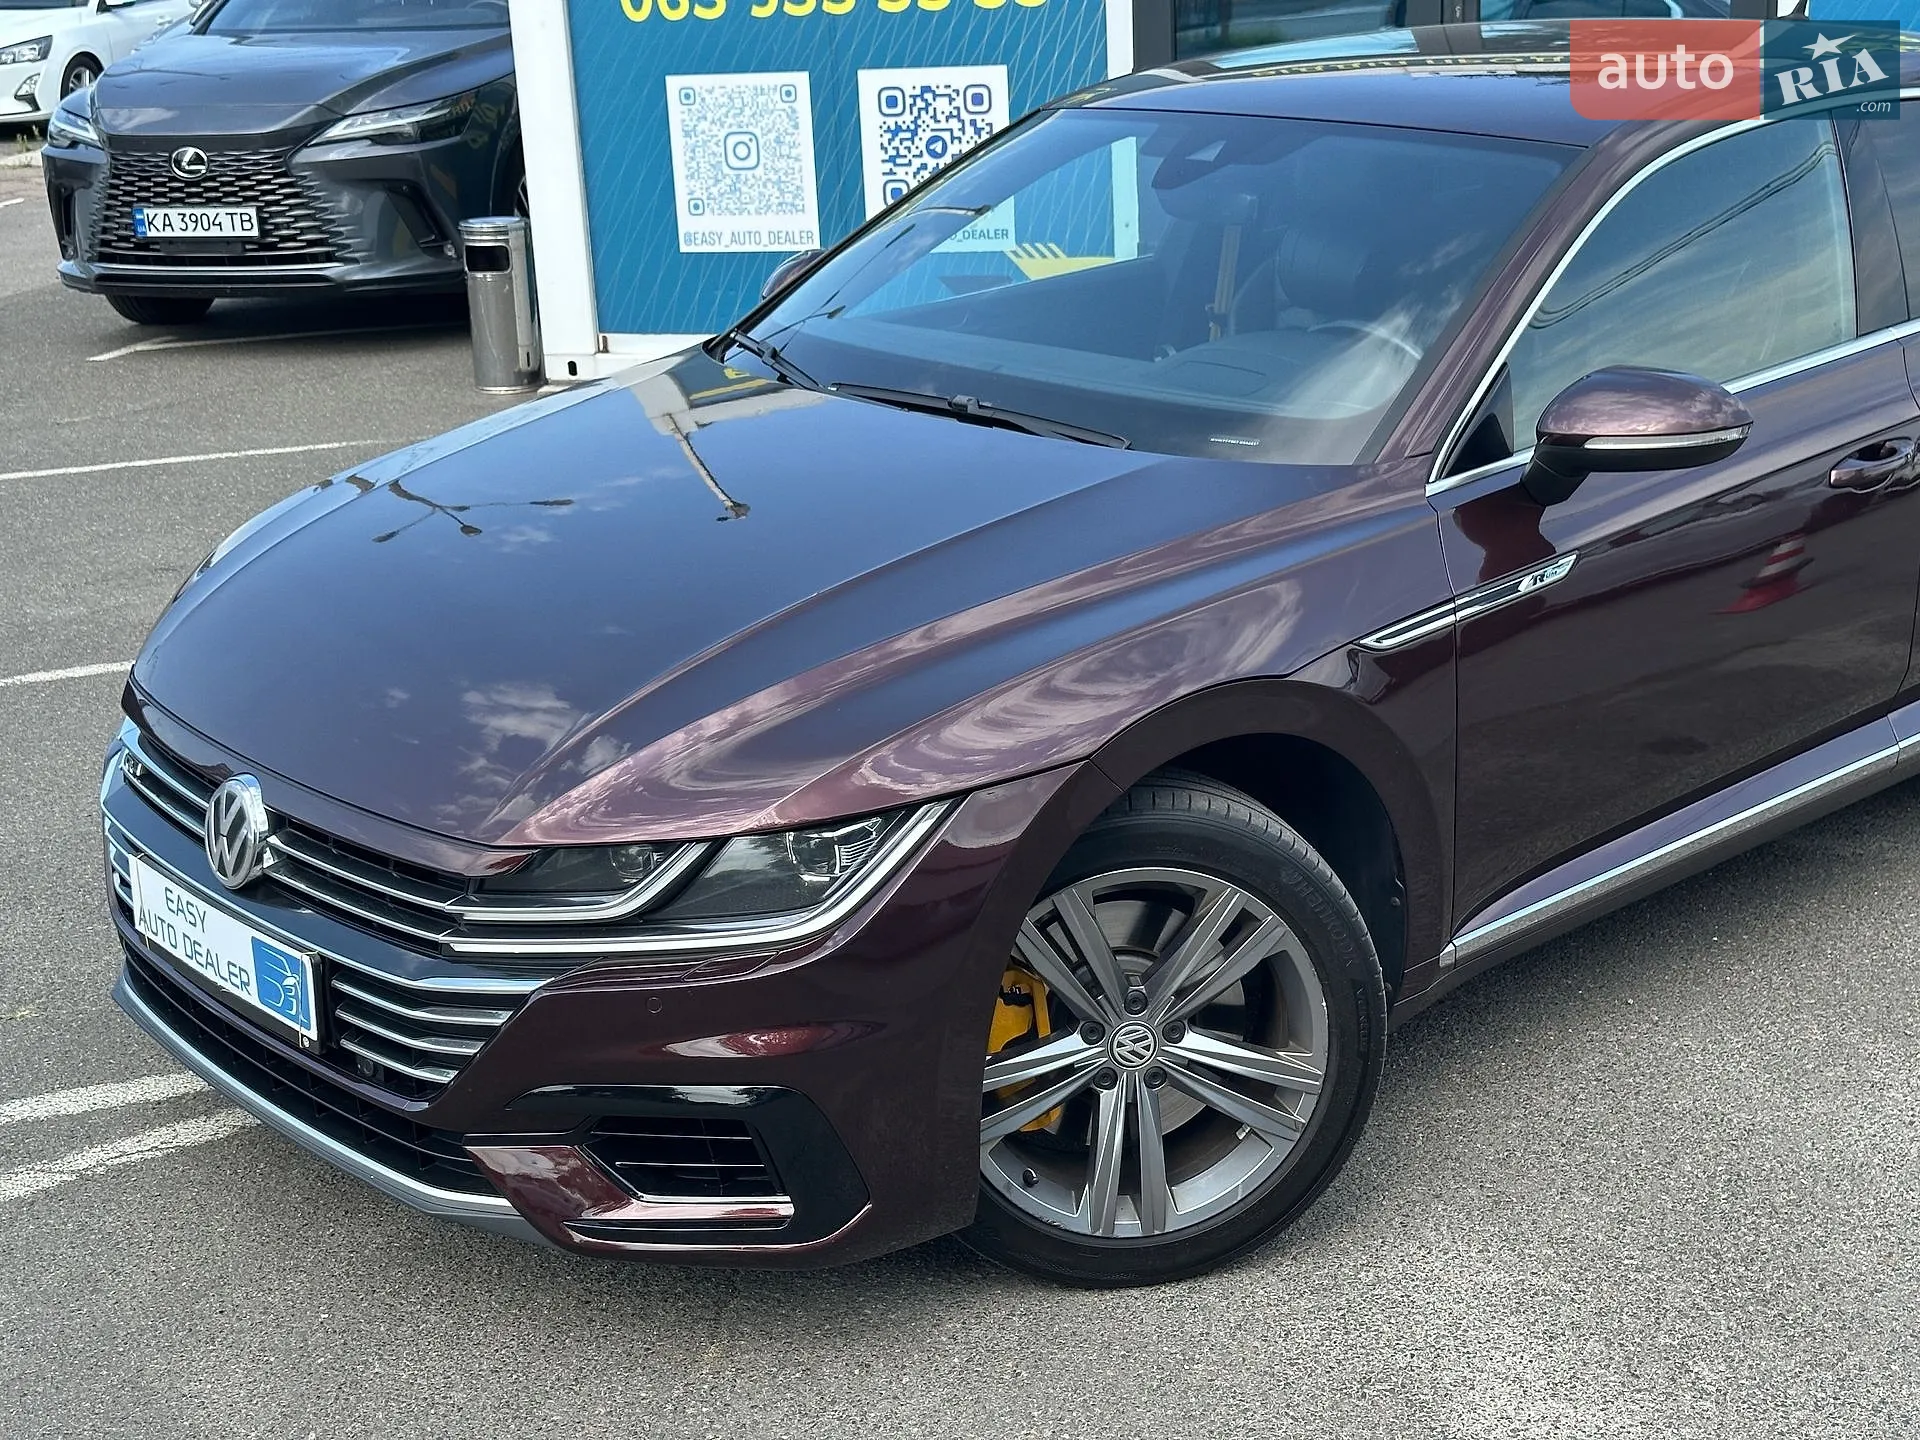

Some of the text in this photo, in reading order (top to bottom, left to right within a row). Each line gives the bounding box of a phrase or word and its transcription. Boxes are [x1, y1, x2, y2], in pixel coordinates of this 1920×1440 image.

[146, 212, 254, 232] KA 3904 TB
[683, 230, 815, 247] @EASY_AUTO_DEALER
[164, 886, 206, 933] EASY
[138, 903, 251, 996] AUTO DEALER
